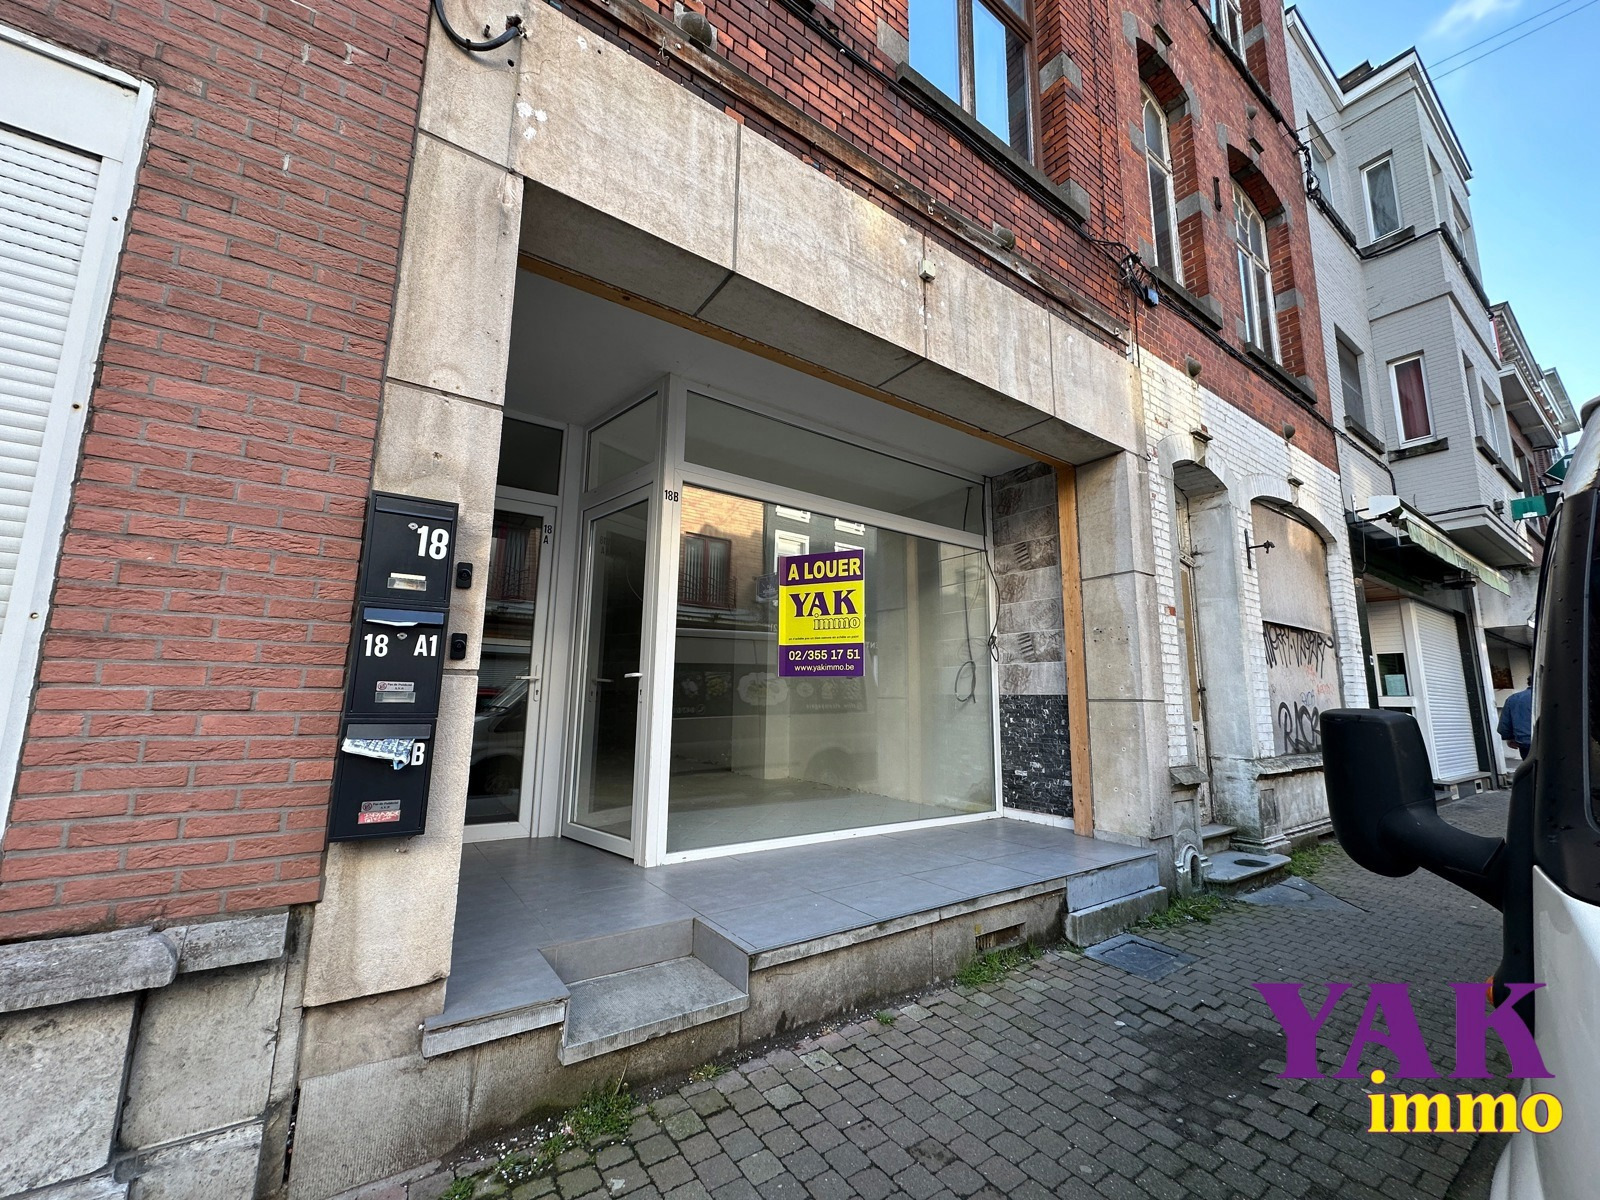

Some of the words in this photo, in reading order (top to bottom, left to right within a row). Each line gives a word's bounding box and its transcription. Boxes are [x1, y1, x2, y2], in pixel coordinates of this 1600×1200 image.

[664, 489, 679, 502] 18B
[543, 524, 553, 535] 18
[417, 525, 449, 560] 18
[543, 535, 549, 544] A
[788, 563, 799, 581] A
[804, 557, 861, 580] LOUER
[789, 589, 859, 618] YAK
[813, 613, 861, 631] immo
[364, 633, 389, 658] 18
[413, 634, 438, 657] A1
[788, 649, 827, 662] 02/355
[830, 649, 843, 660] 17
[846, 649, 860, 660] 51
[794, 663, 855, 673] www.yakimmo.be
[410, 742, 426, 766] B
